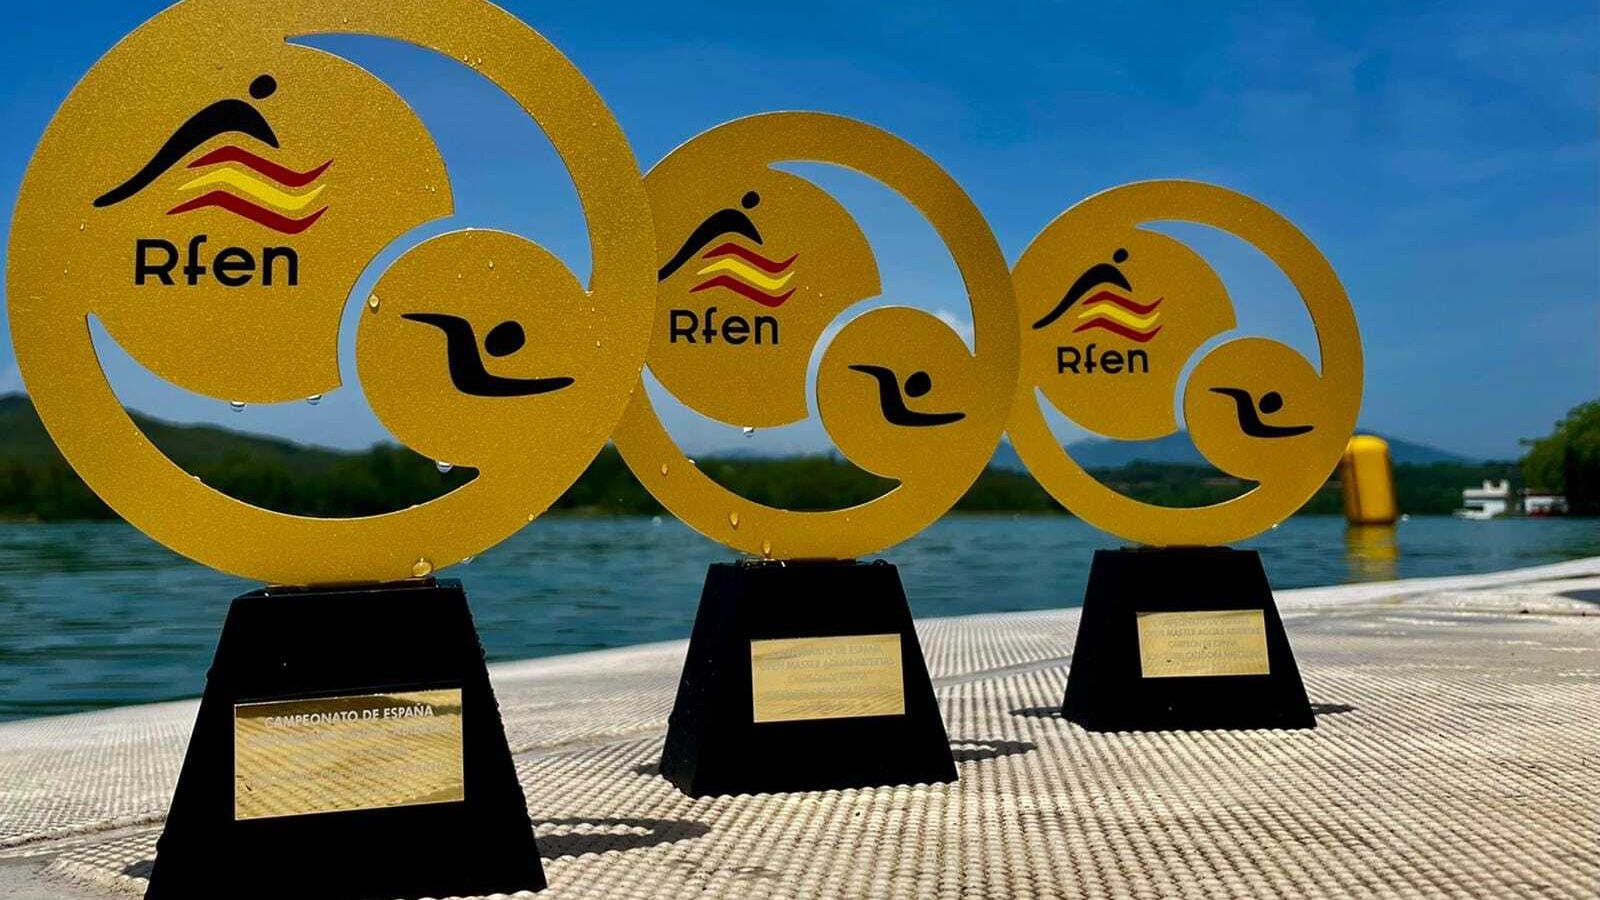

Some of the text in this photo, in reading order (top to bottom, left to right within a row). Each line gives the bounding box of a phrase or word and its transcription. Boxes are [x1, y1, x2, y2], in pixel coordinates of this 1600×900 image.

[134, 235, 299, 286] Rfen
[669, 307, 779, 345] Rfen
[1057, 344, 1149, 374] Rfen
[265, 703, 434, 728] CAMPEONATO DE ESPAÑA
